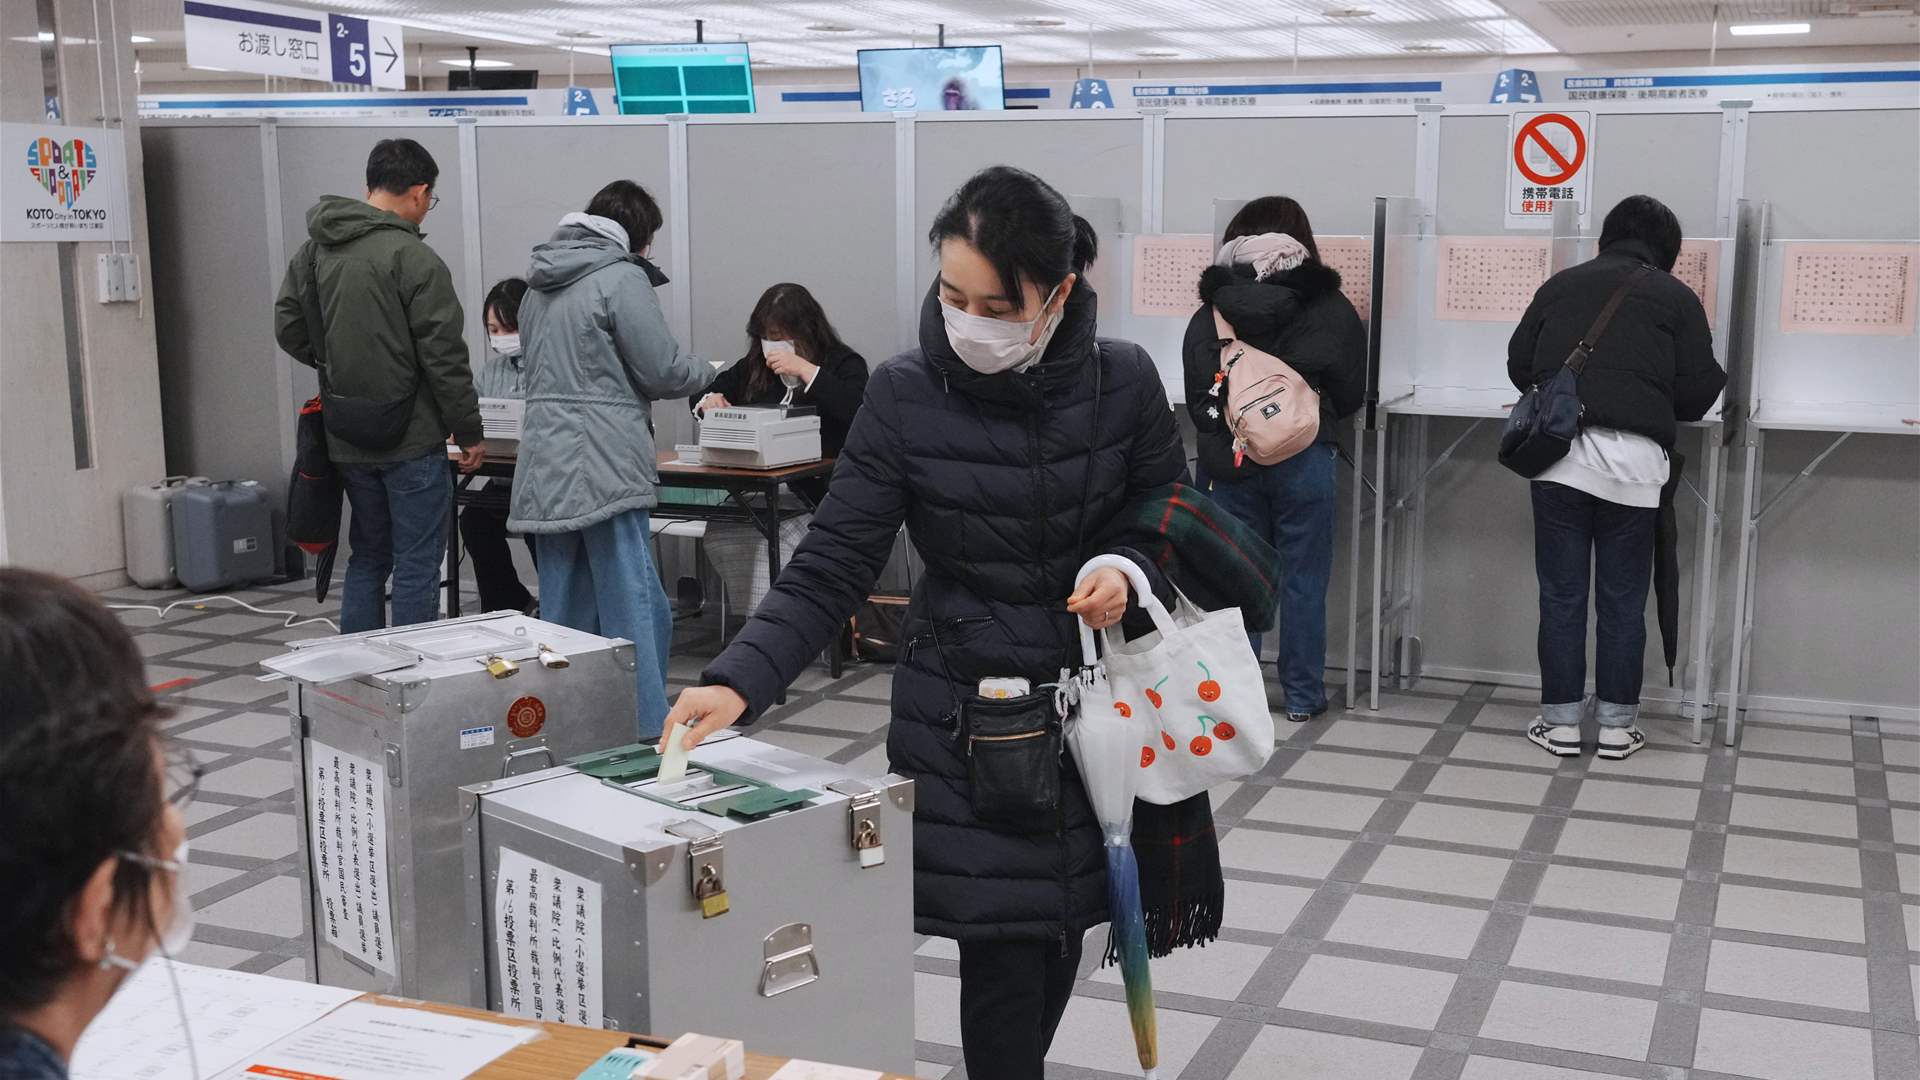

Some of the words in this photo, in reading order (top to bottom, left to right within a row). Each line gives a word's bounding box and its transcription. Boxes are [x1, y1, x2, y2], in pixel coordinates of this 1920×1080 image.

[337, 23, 348, 38] 2-
[239, 32, 318, 60] お渡し窓口
[350, 43, 366, 77] 5
[27, 137, 97, 169] SPORTS
[58, 165, 70, 180] &
[30, 167, 97, 210] SUPPORTS
[1522, 187, 1574, 200] 携帯電話
[27, 208, 54, 220] KOTO
[73, 209, 106, 220] TOKYO
[504, 879, 520, 1012] 第16投票区投票所
